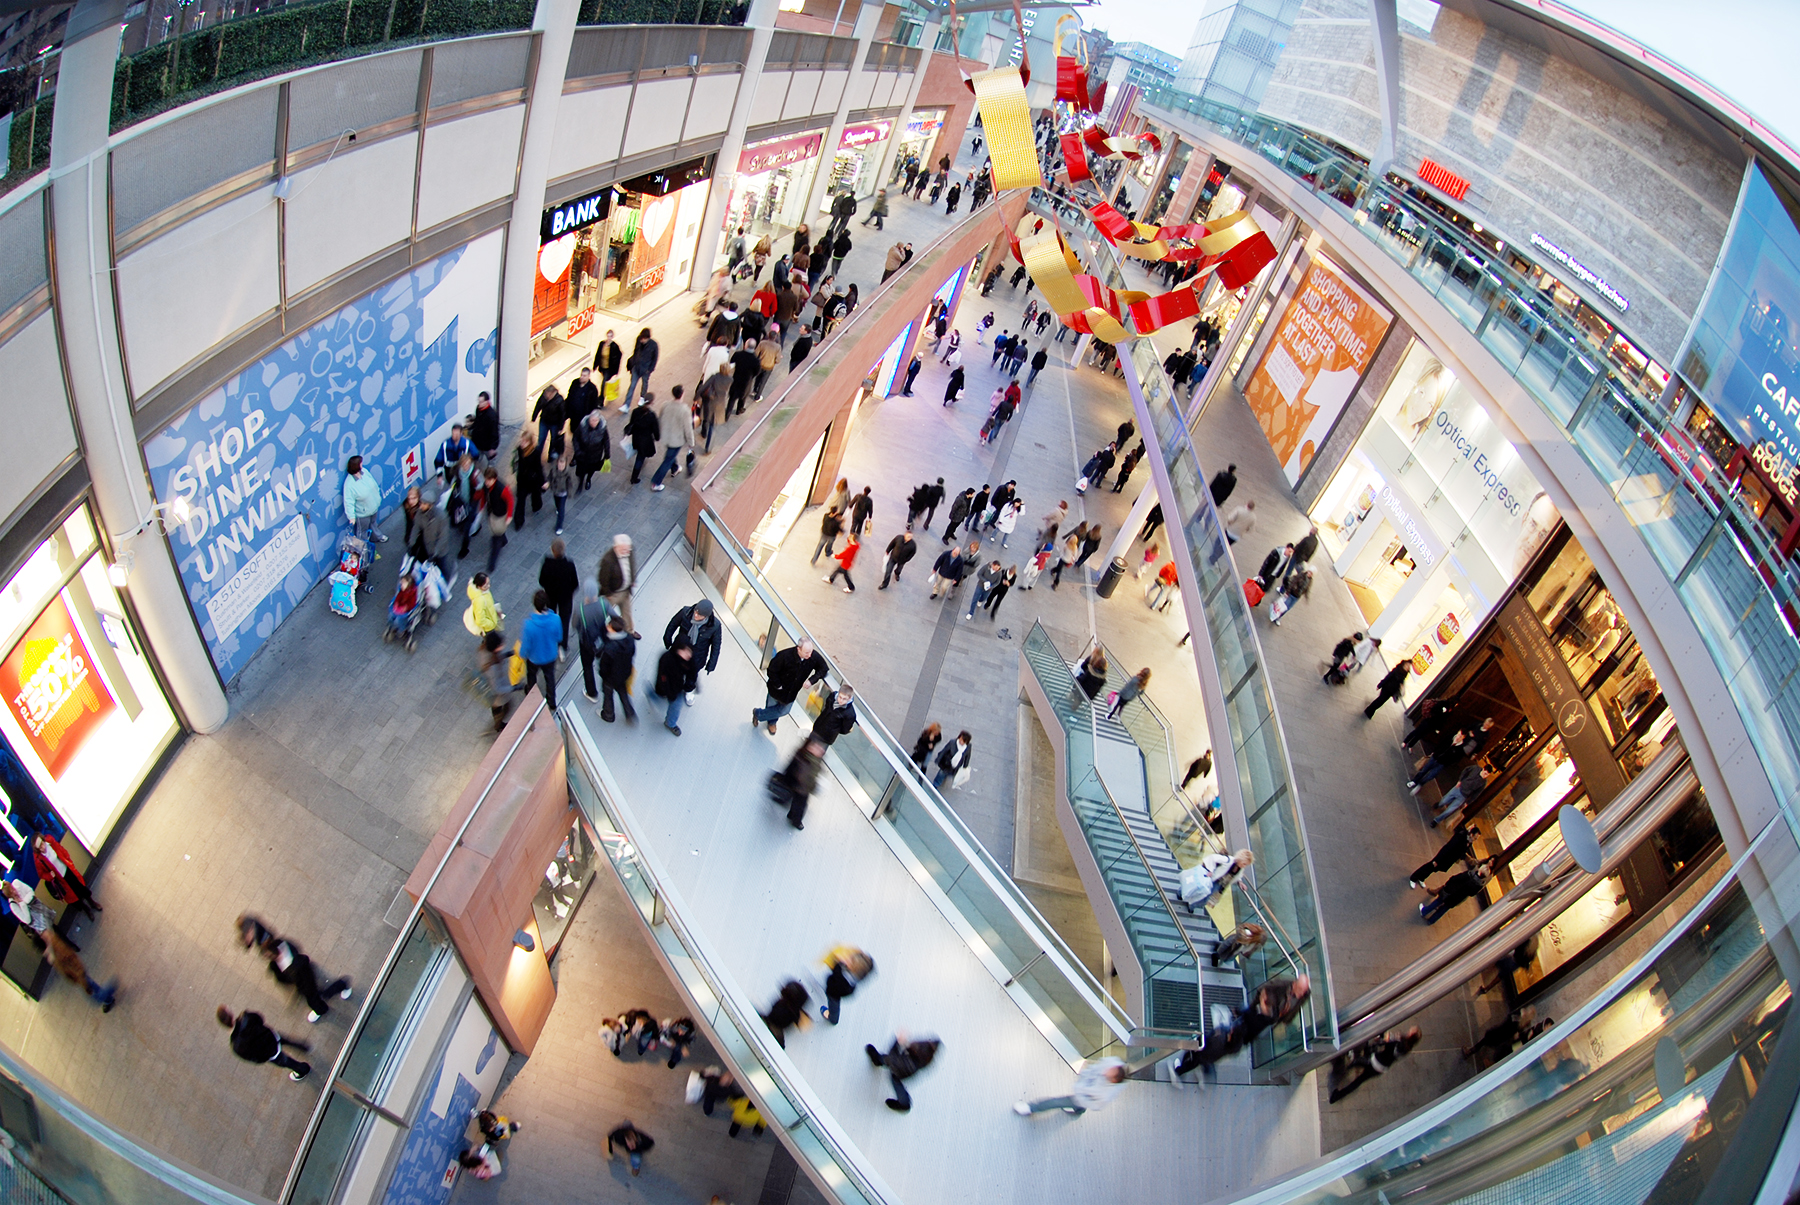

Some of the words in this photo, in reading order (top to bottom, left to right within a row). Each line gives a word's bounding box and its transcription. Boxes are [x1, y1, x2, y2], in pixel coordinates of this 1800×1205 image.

[749, 148, 798, 172] Superdrug
[552, 195, 602, 236] BANK
[532, 279, 569, 316] ALE
[643, 266, 666, 290] 50%
[1310, 268, 1358, 323] SHOPPING
[1530, 232, 1569, 264] gourmet
[1566, 256, 1599, 281] burger
[1595, 277, 1630, 311] kitchen
[568, 306, 595, 336] 50%
[1282, 322, 1297, 342] AT
[1292, 331, 1317, 366] LAST
[1292, 303, 1337, 361] TOGETHER
[1300, 287, 1322, 313] AND
[1319, 304, 1368, 369] PLAYTIME,
[173, 409, 270, 503] SHOP.
[1436, 411, 1478, 461] Optical
[1473, 453, 1521, 517] Express
[1752, 443, 1799, 506] ROUGE
[184, 456, 271, 547] DINE.
[195, 459, 326, 583] UNWIND.
[1382, 486, 1410, 524] Optical
[1404, 518, 1435, 566] Express
[243, 550, 268, 580] SQFT
[269, 537, 282, 553] TO
[284, 519, 301, 541] LET
[1443, 615, 1460, 635] SALE
[1507, 624, 1528, 658] LIVERPOOL
[1532, 669, 1542, 683] LOT
[26, 646, 85, 722] 50%
[1419, 646, 1435, 666] SALE
[1536, 649, 1563, 695] SPITALFIELDS
[12, 681, 35, 707] THE
